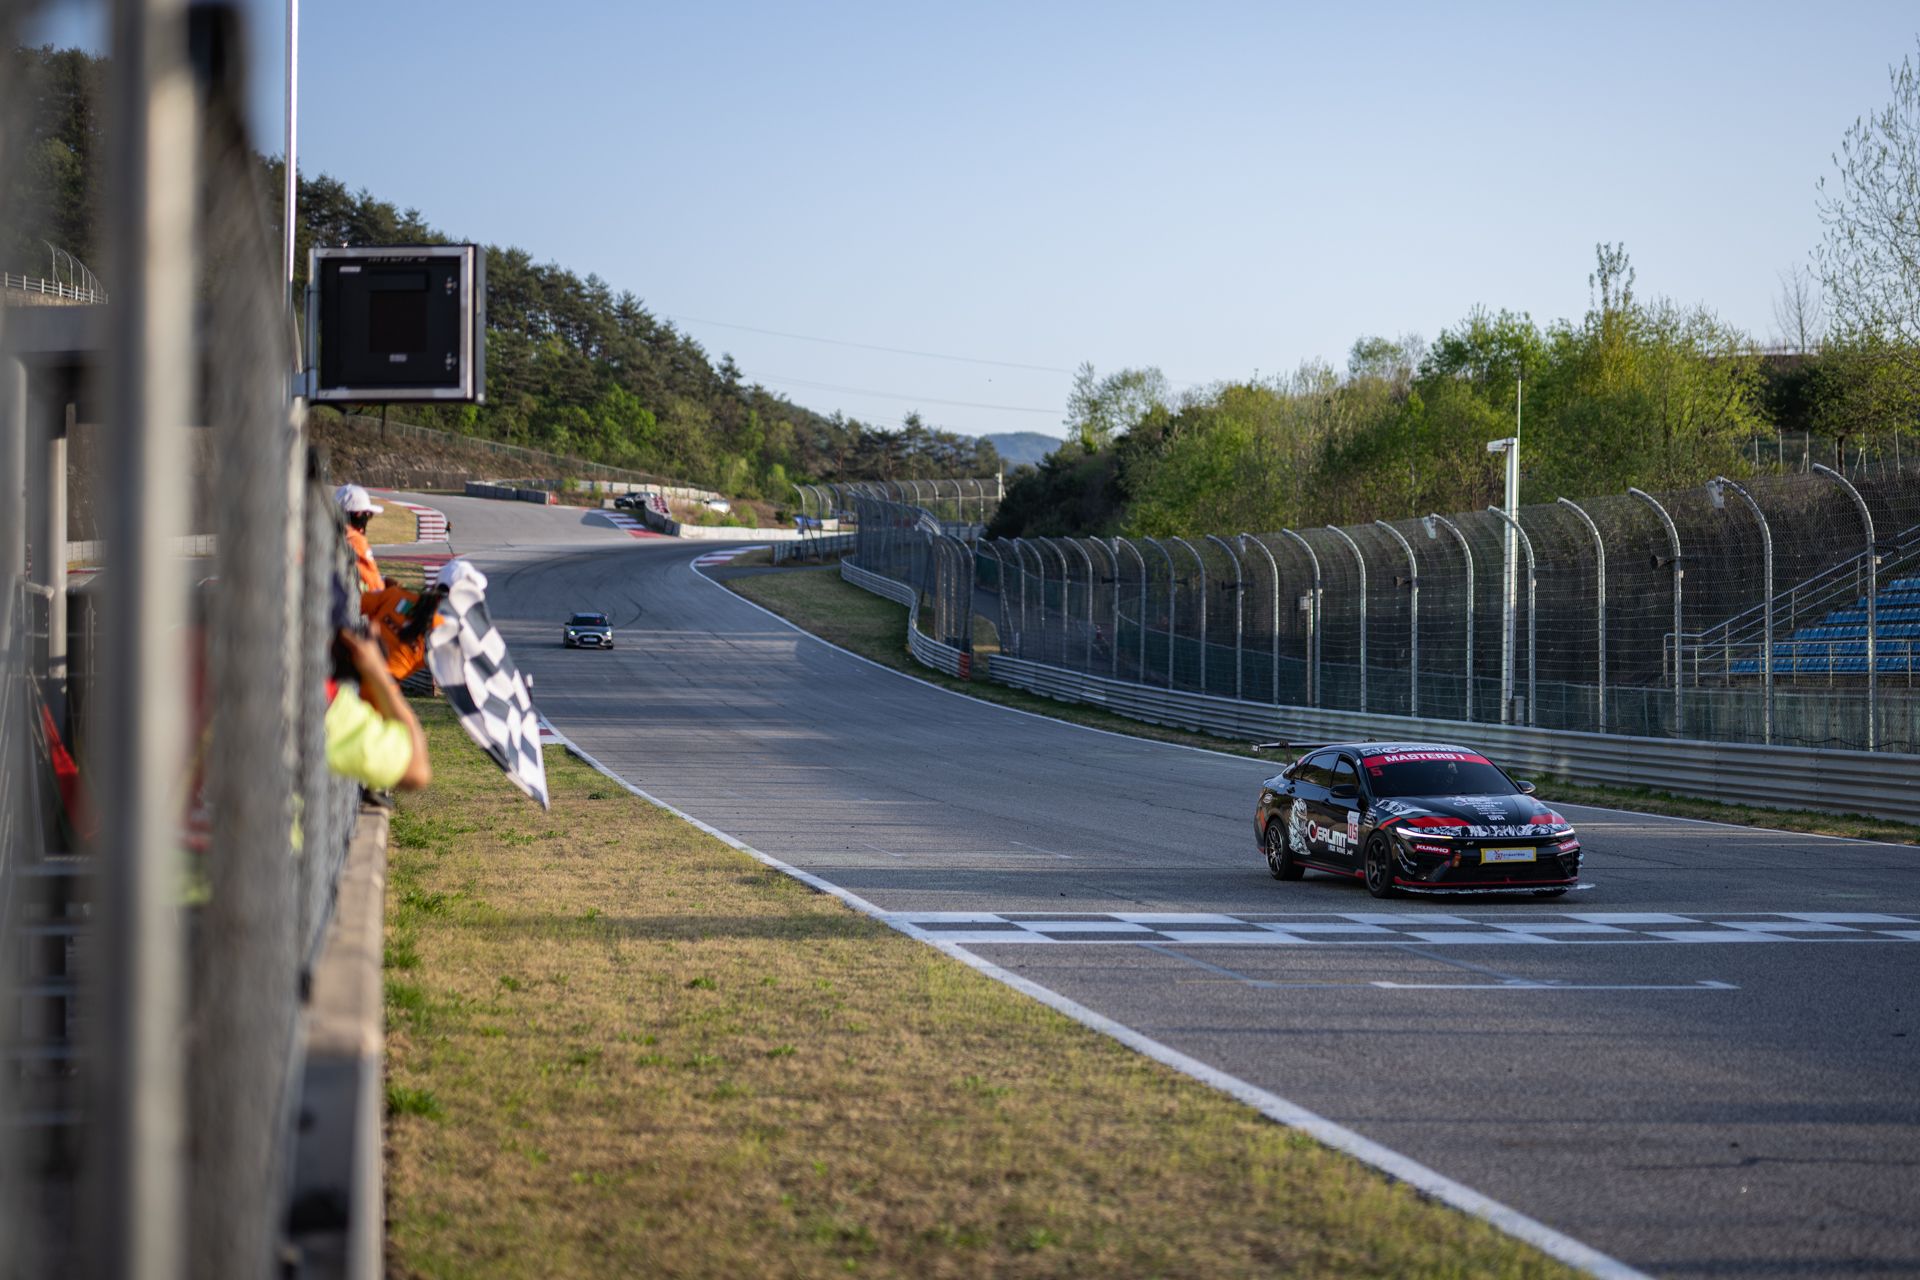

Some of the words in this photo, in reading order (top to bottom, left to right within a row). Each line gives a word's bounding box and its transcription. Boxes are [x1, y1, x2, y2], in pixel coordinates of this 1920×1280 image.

[1384, 753, 1456, 762] MASTERS
[1370, 766, 1383, 776] 5
[1348, 823, 1358, 841] 05
[1416, 844, 1449, 853] KUMHO
